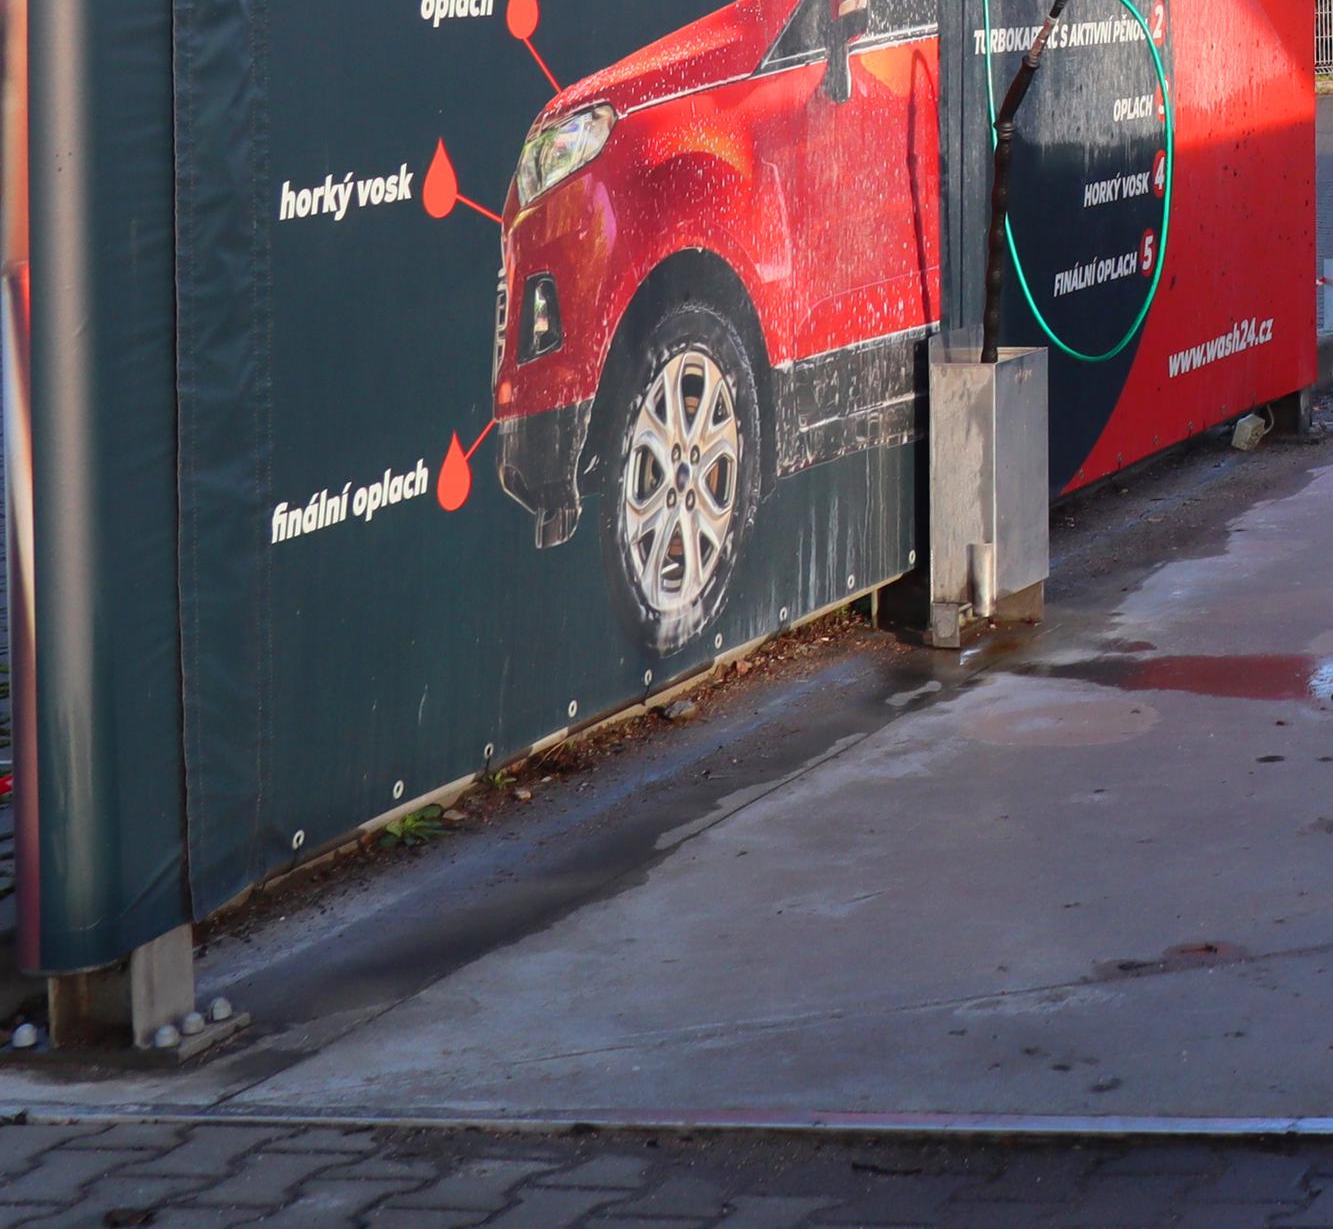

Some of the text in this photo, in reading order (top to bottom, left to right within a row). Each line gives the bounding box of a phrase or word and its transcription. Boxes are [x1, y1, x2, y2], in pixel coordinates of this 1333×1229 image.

[1059, 23, 1069, 49] S
[1068, 15, 1114, 48] AKTIVNÍ
[1153, 4, 1164, 39] 2
[1113, 93, 1154, 122] OPLACH
[279, 162, 414, 222] horký vosk
[1083, 156, 1165, 208] HORKÝ VOSK 4
[1053, 234, 1153, 298] FINÁLNÍ OPLACH 5
[1168, 316, 1274, 379] www.wash24.cz
[271, 458, 429, 544] finální oplach
